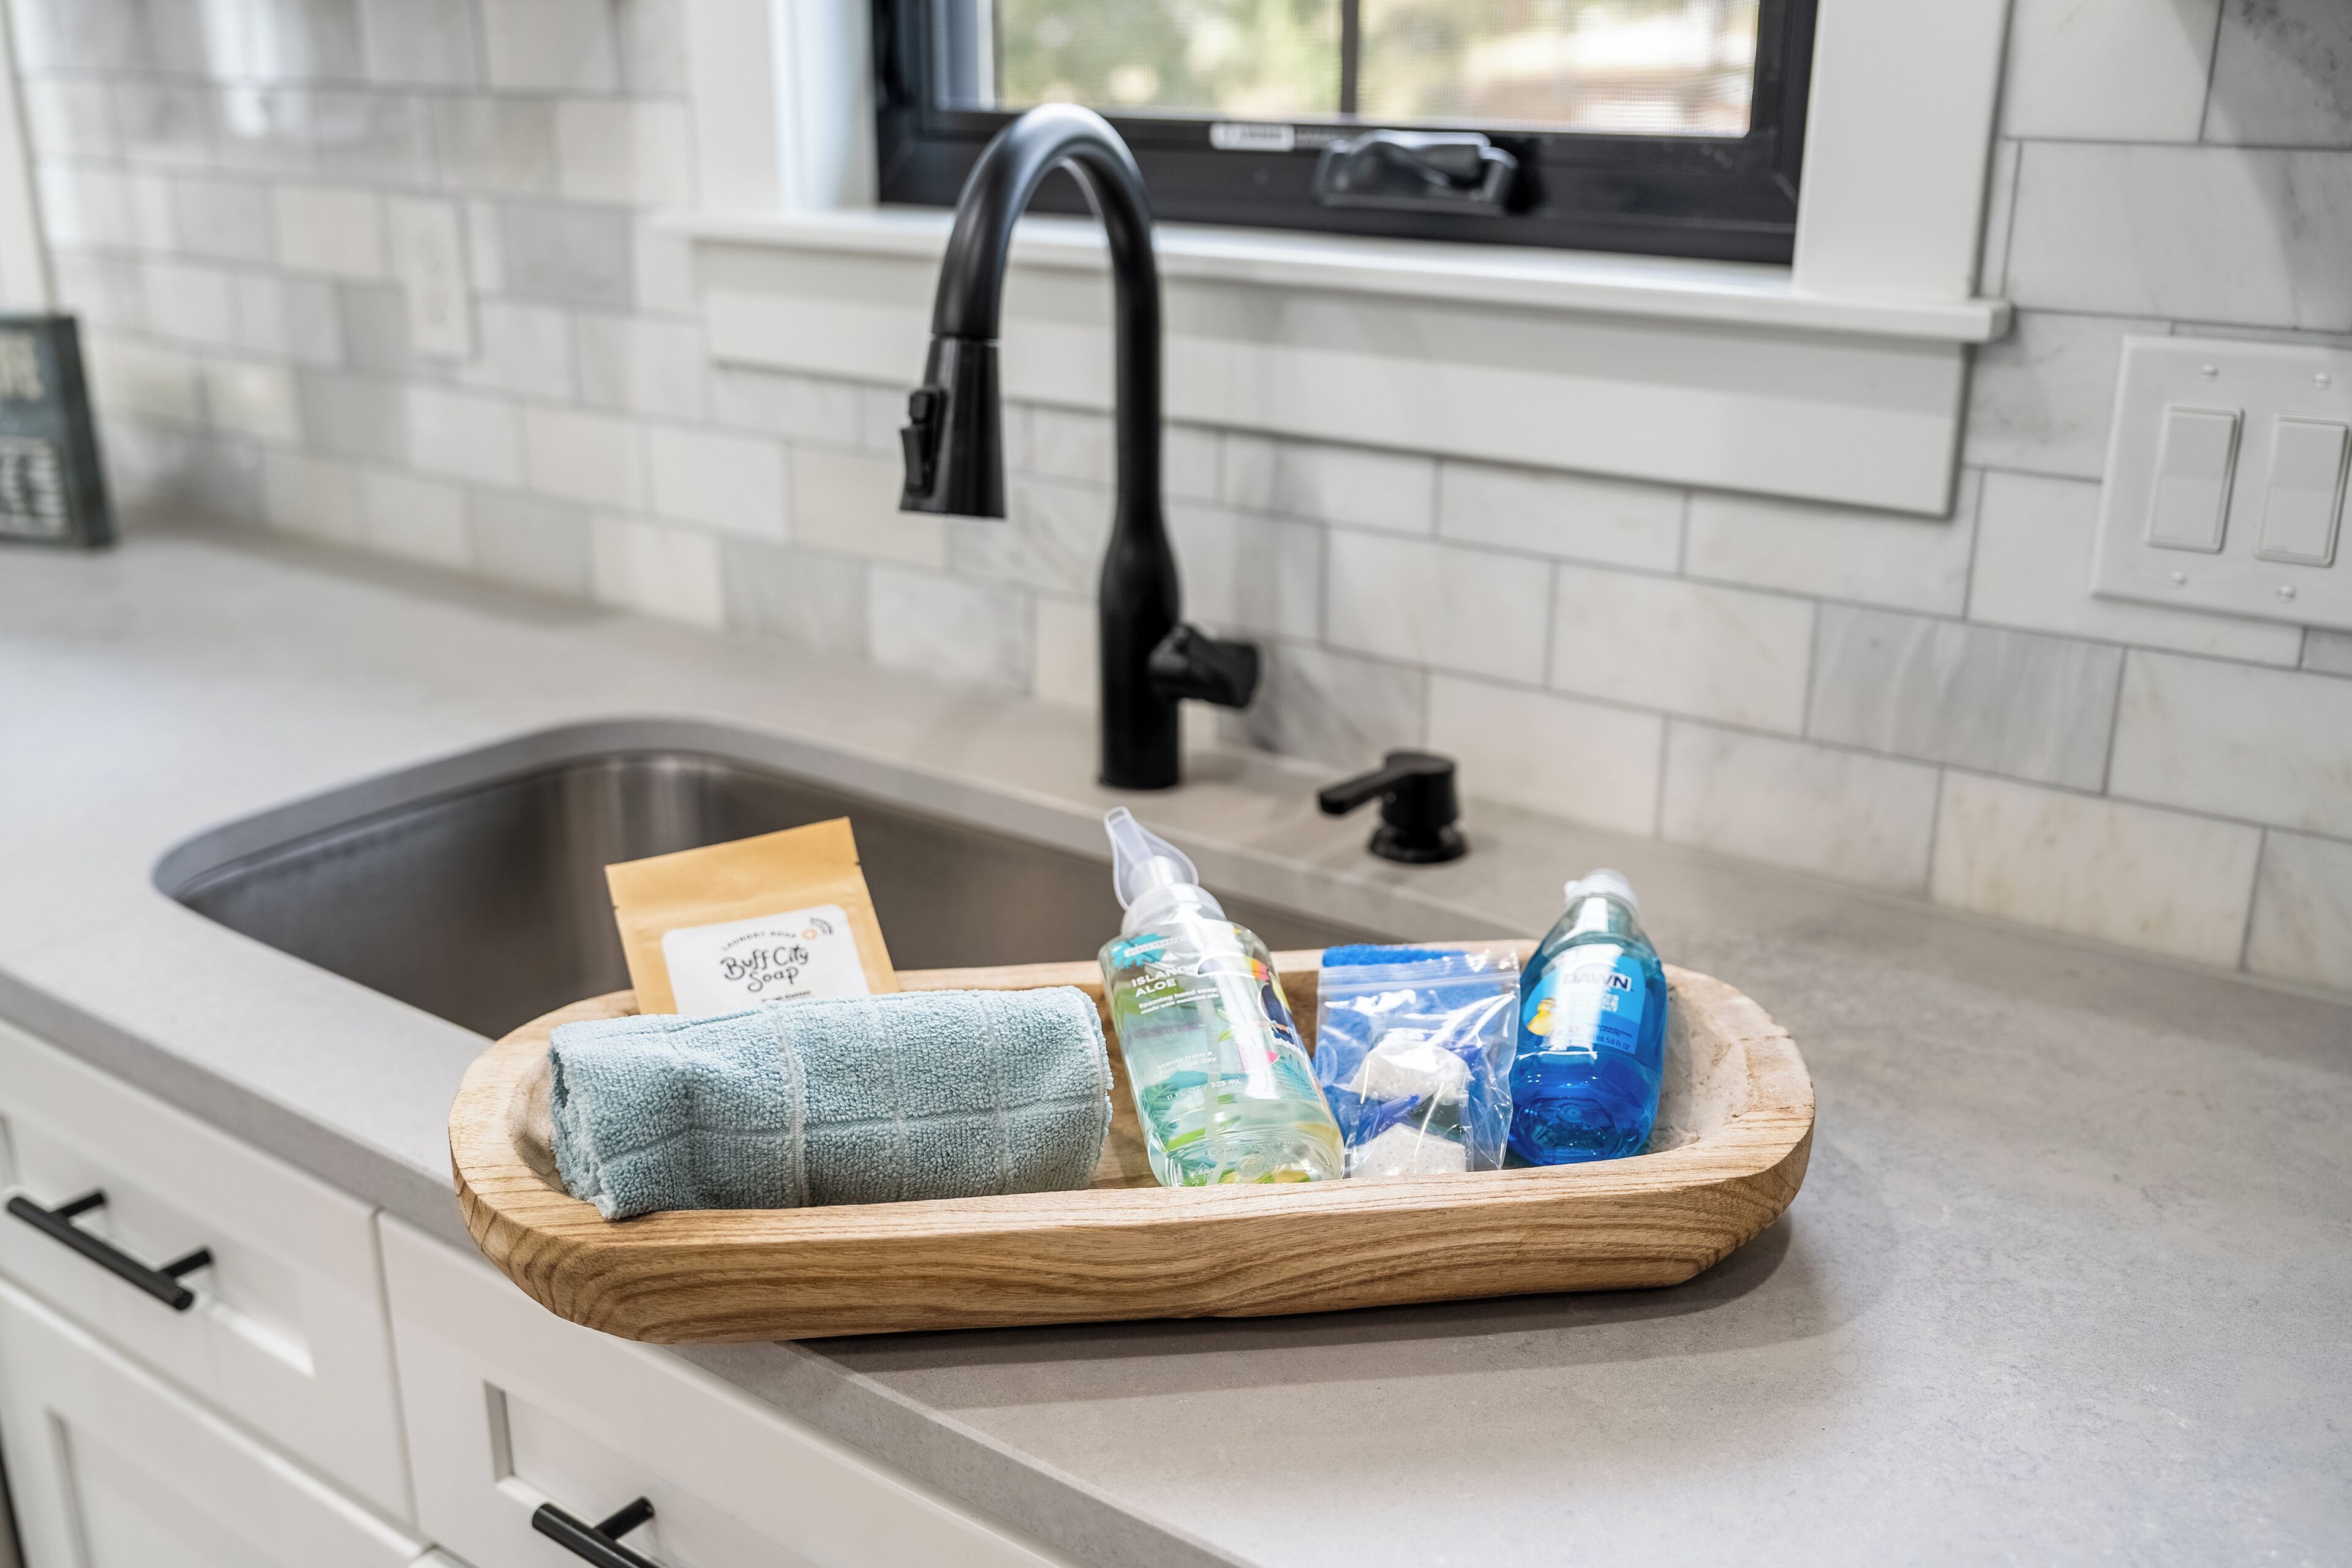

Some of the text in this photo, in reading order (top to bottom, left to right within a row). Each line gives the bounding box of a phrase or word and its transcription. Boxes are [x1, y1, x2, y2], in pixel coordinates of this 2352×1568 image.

[720, 944, 809, 980] Buff City
[747, 967, 799, 992] Soap
[1131, 965, 1186, 987] ISLAND
[1135, 978, 1177, 997] ALOE
[1139, 994, 1174, 1009] foaming
[1174, 989, 1196, 998] hand
[1140, 1005, 1160, 1015] made
[1157, 1057, 1183, 1069] scents
[1185, 1052, 1205, 1061] from
[1210, 1080, 1226, 1088] 325
